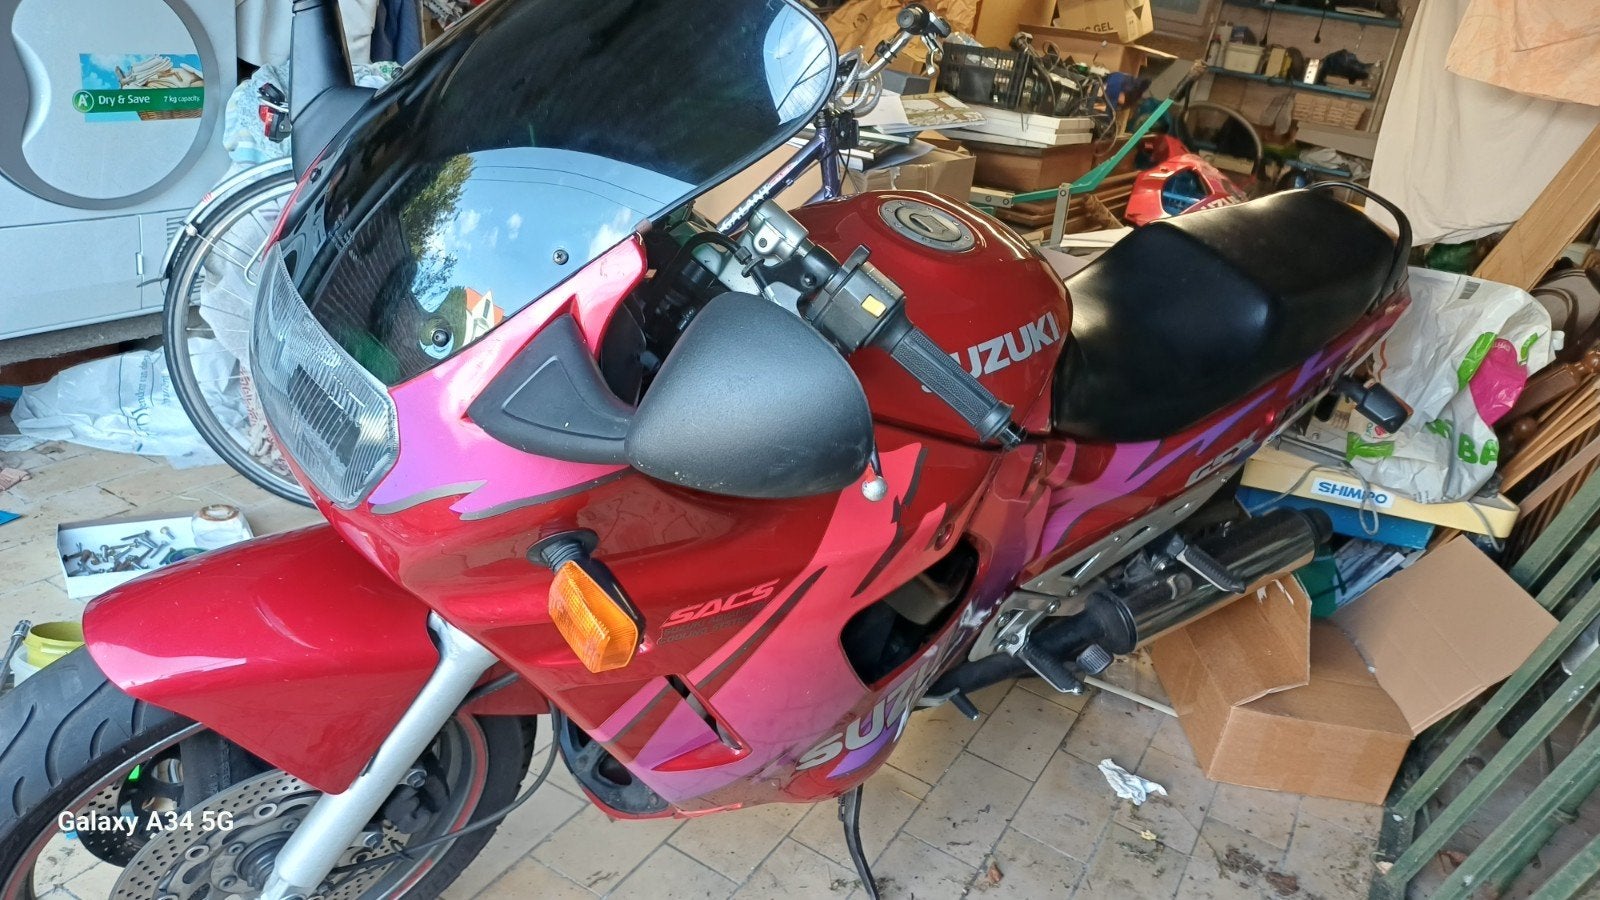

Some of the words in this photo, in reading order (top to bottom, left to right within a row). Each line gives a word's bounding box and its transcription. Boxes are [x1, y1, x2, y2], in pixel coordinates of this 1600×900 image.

[1093, 21, 1114, 32] GEL
[98, 95, 115, 107] Dry
[117, 94, 126, 105] &
[128, 95, 151, 104] Save
[169, 95, 177, 104] kg
[178, 95, 200, 103] capacity
[921, 311, 1061, 393] UZUKI
[660, 578, 780, 629] SACS
